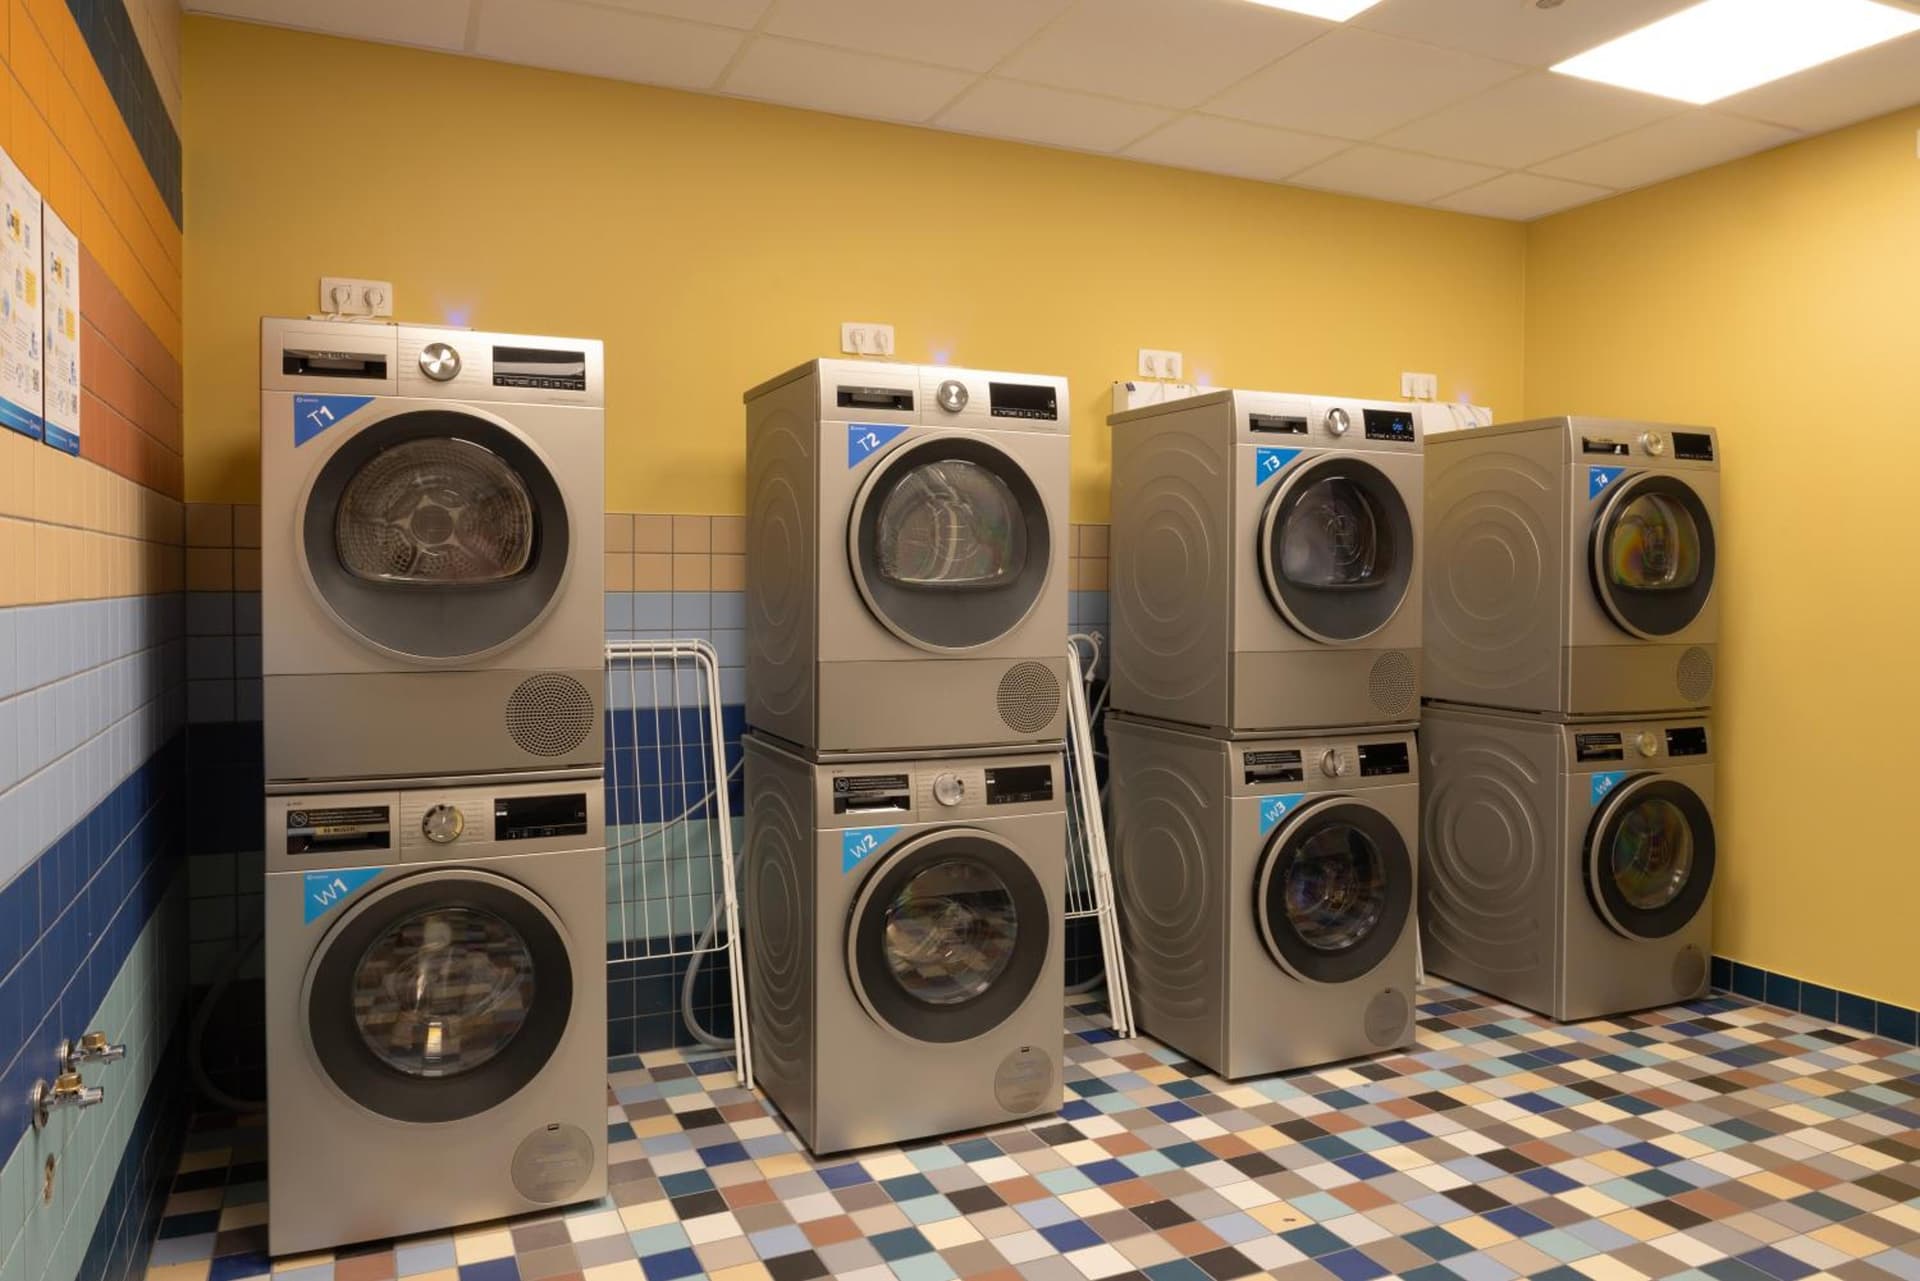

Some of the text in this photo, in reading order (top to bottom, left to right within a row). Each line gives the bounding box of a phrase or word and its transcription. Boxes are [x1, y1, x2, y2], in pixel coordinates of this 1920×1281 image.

[307, 405, 335, 428] T1
[857, 432, 881, 452] T2
[1263, 455, 1281, 473] T3
[1595, 473, 1609, 488] T4
[1265, 801, 1286, 822] W3
[850, 834, 878, 859] W2
[314, 878, 348, 906] W1
